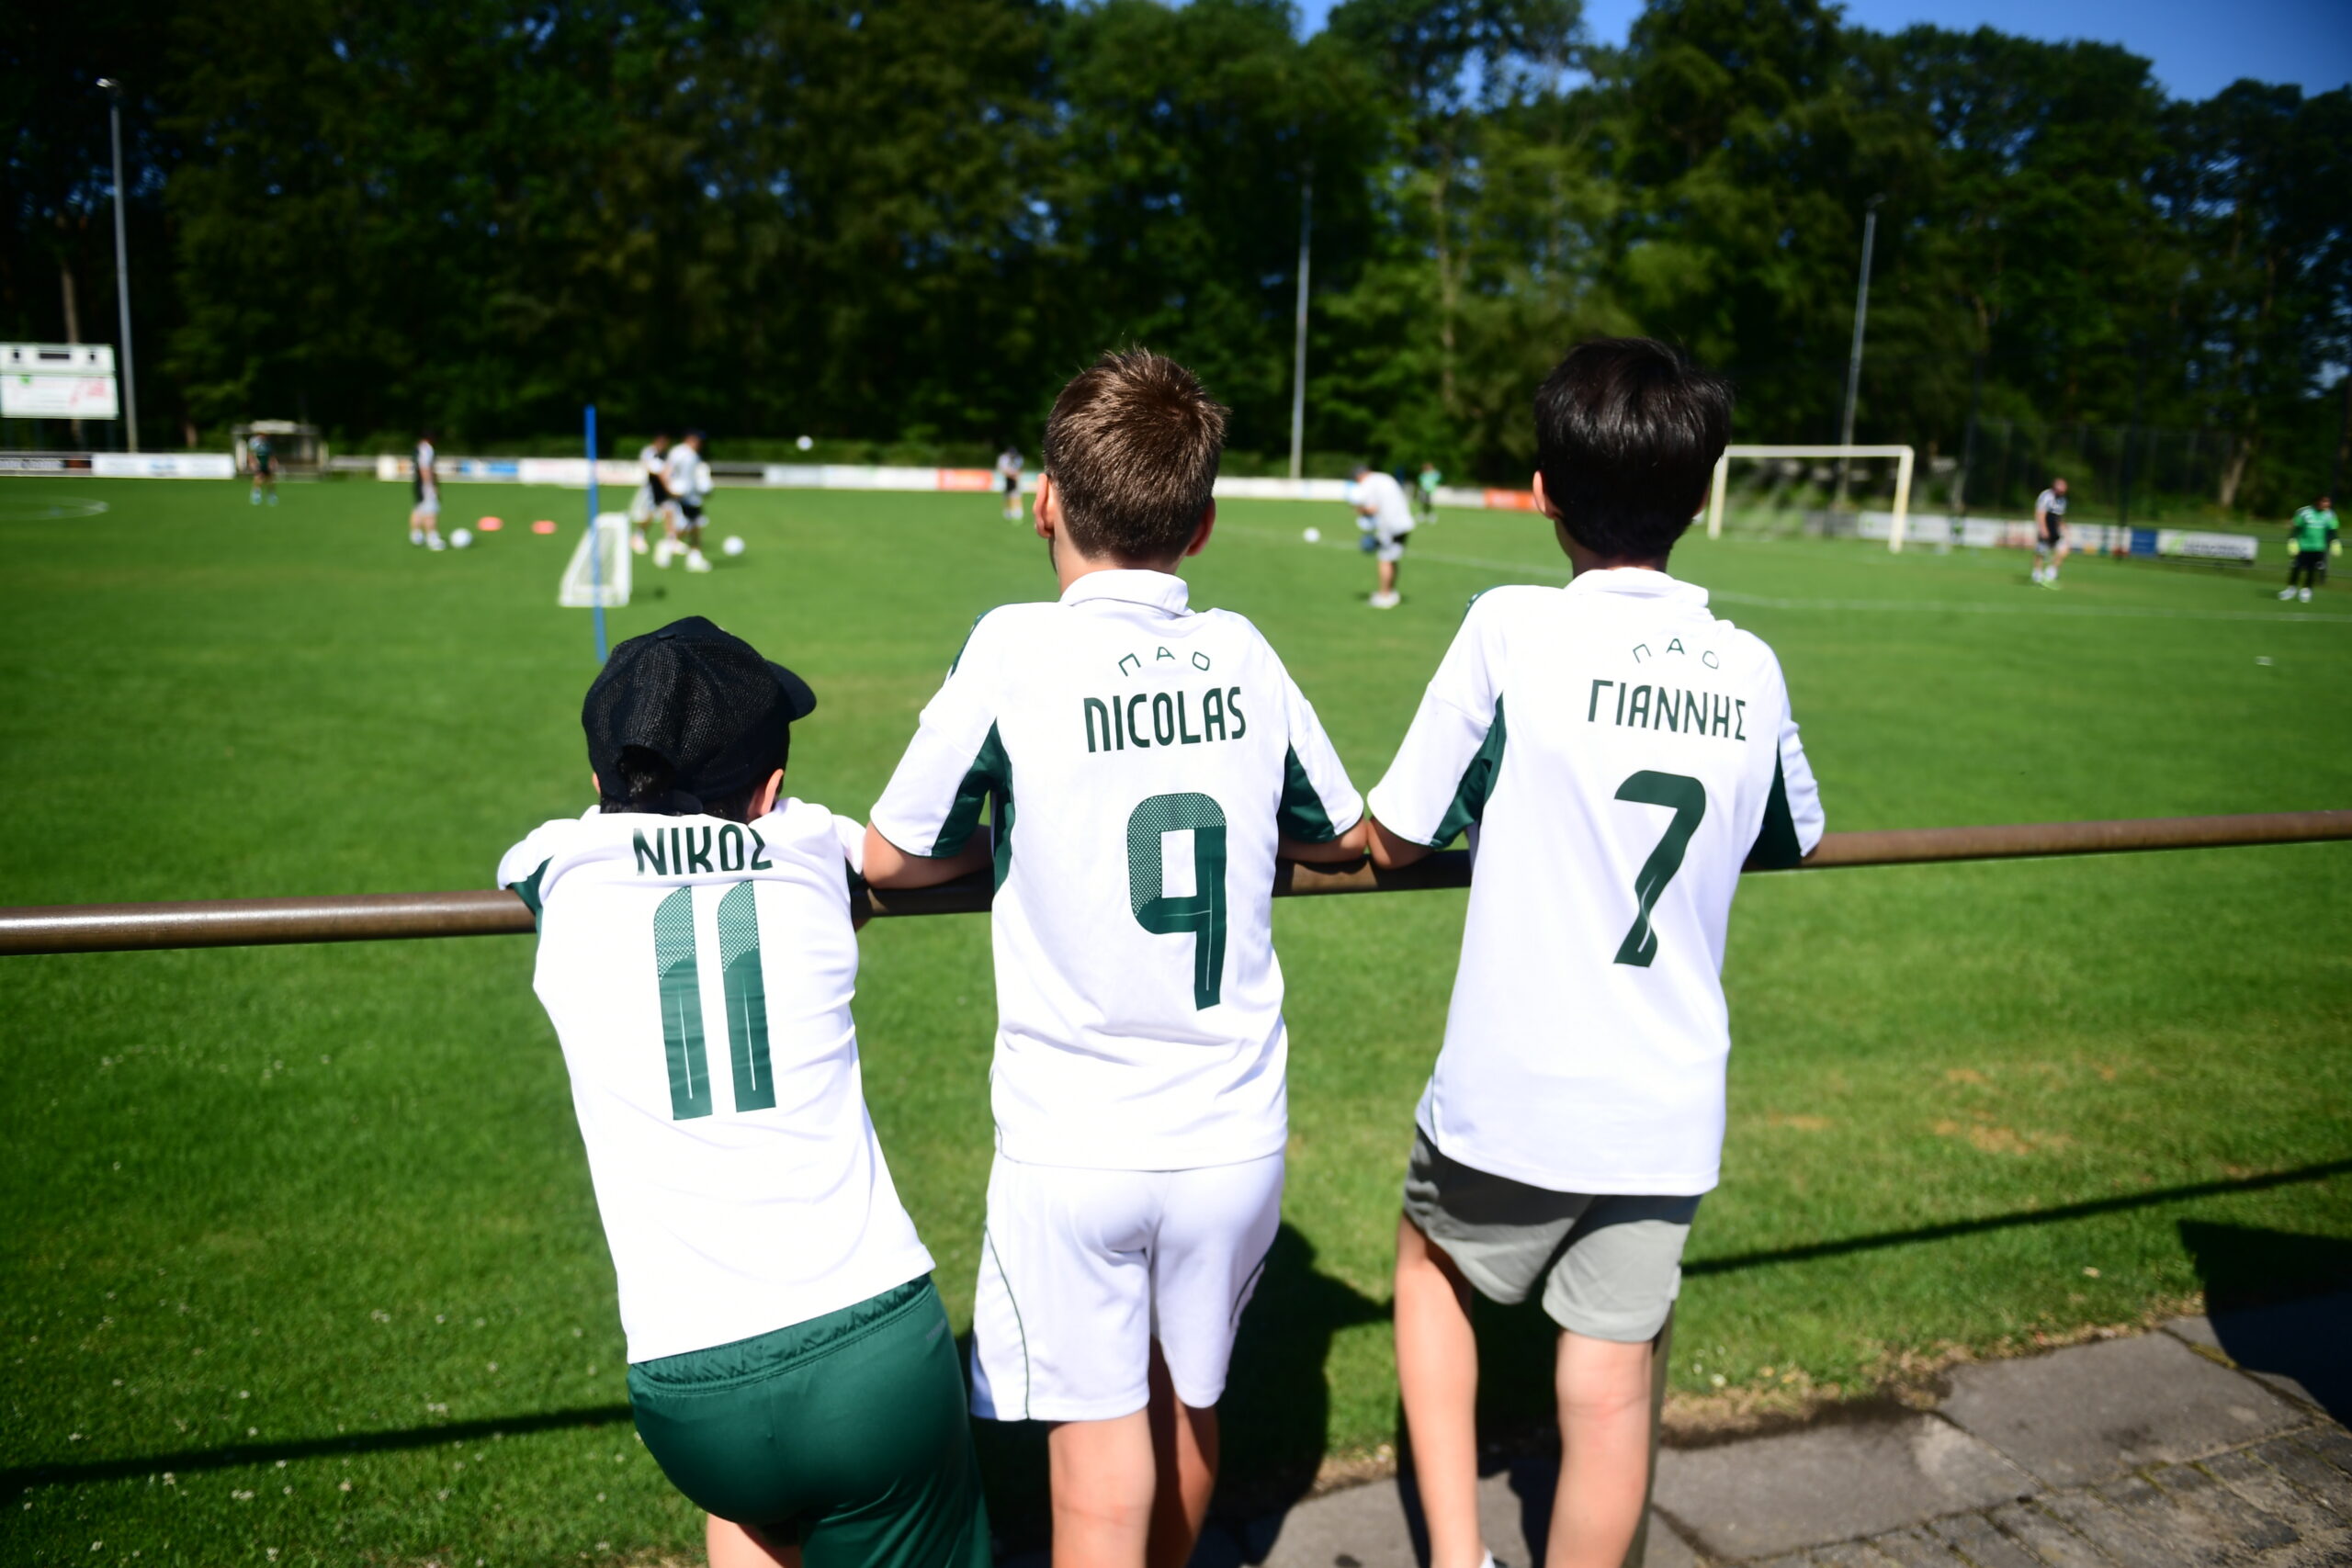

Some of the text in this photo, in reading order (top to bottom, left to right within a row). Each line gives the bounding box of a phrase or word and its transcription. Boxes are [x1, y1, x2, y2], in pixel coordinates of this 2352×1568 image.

[1083, 686, 1247, 753] NICOLAS
[1588, 679, 1747, 741] ΓΙΑΝΝΗΣ
[633, 823, 773, 876] ΝΙΚΟΣ
[1126, 792, 1227, 1011] 9
[1613, 770, 1706, 967] 7
[653, 879, 777, 1121] 11
